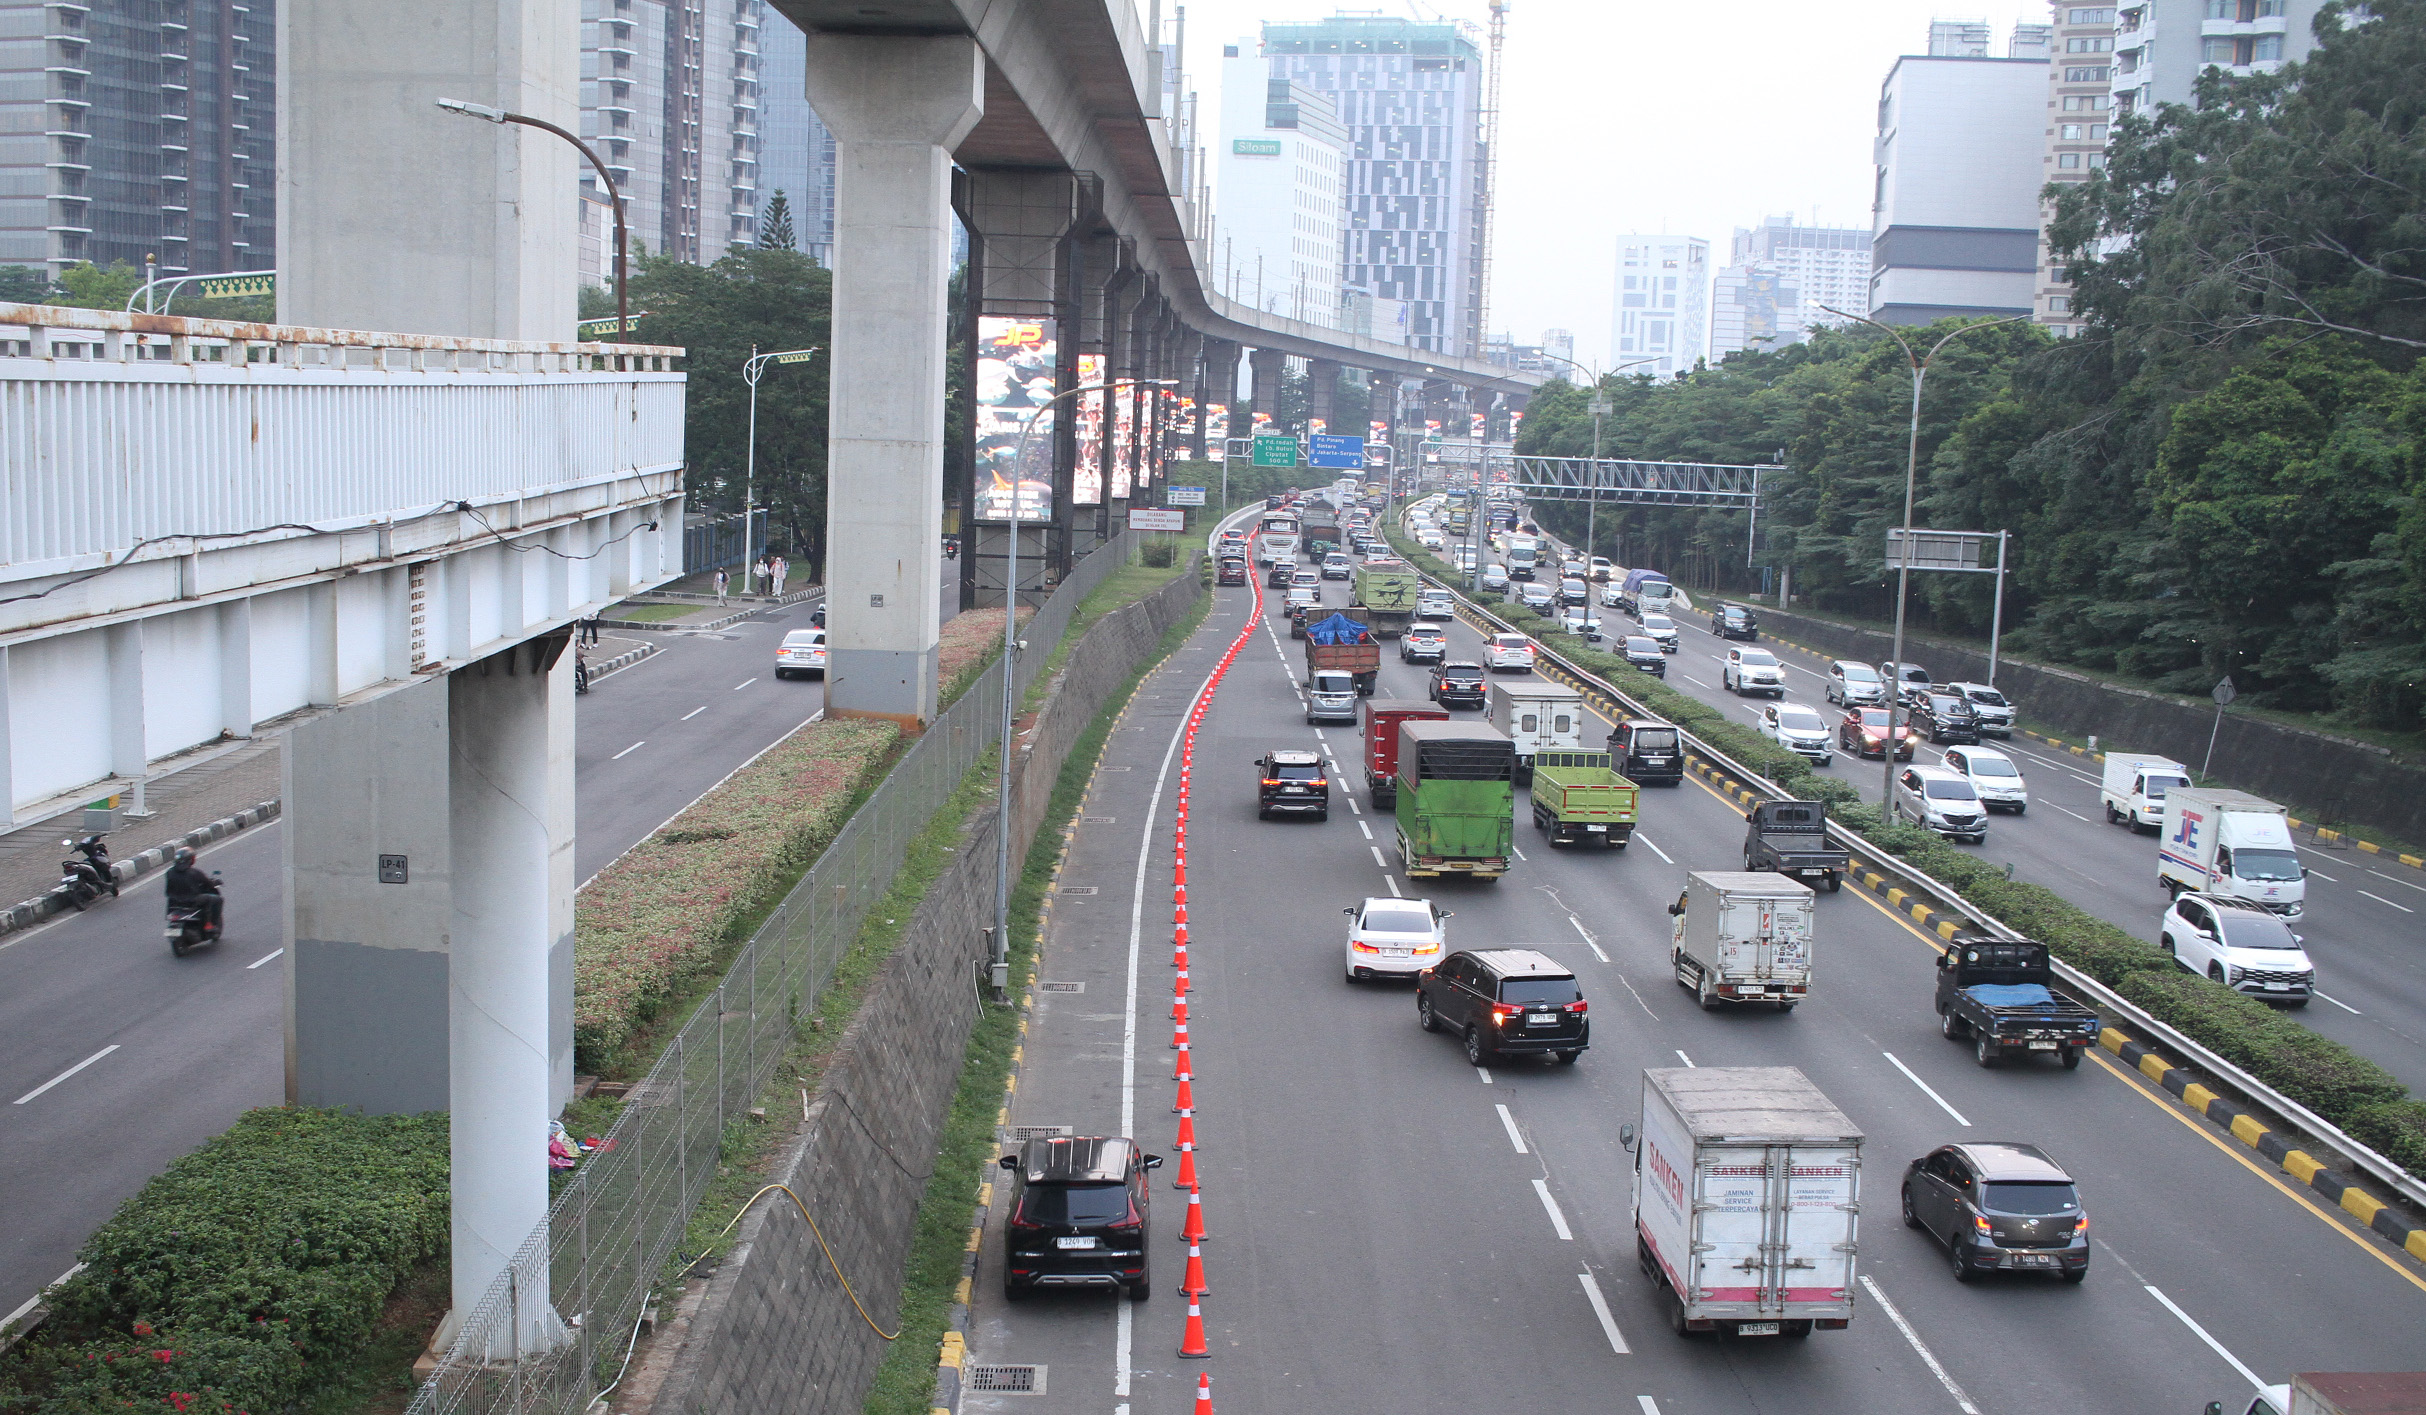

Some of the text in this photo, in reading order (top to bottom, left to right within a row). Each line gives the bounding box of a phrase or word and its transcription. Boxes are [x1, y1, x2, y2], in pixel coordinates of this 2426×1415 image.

[1238, 141, 1276, 152] Siloam
[382, 859, 405, 869] LP-41
[1650, 1141, 1684, 1211] SANKEN
[1712, 1167, 1842, 1176] SANKEN SANKEN
[1718, 1205, 1759, 1213] TERPERCAYA
